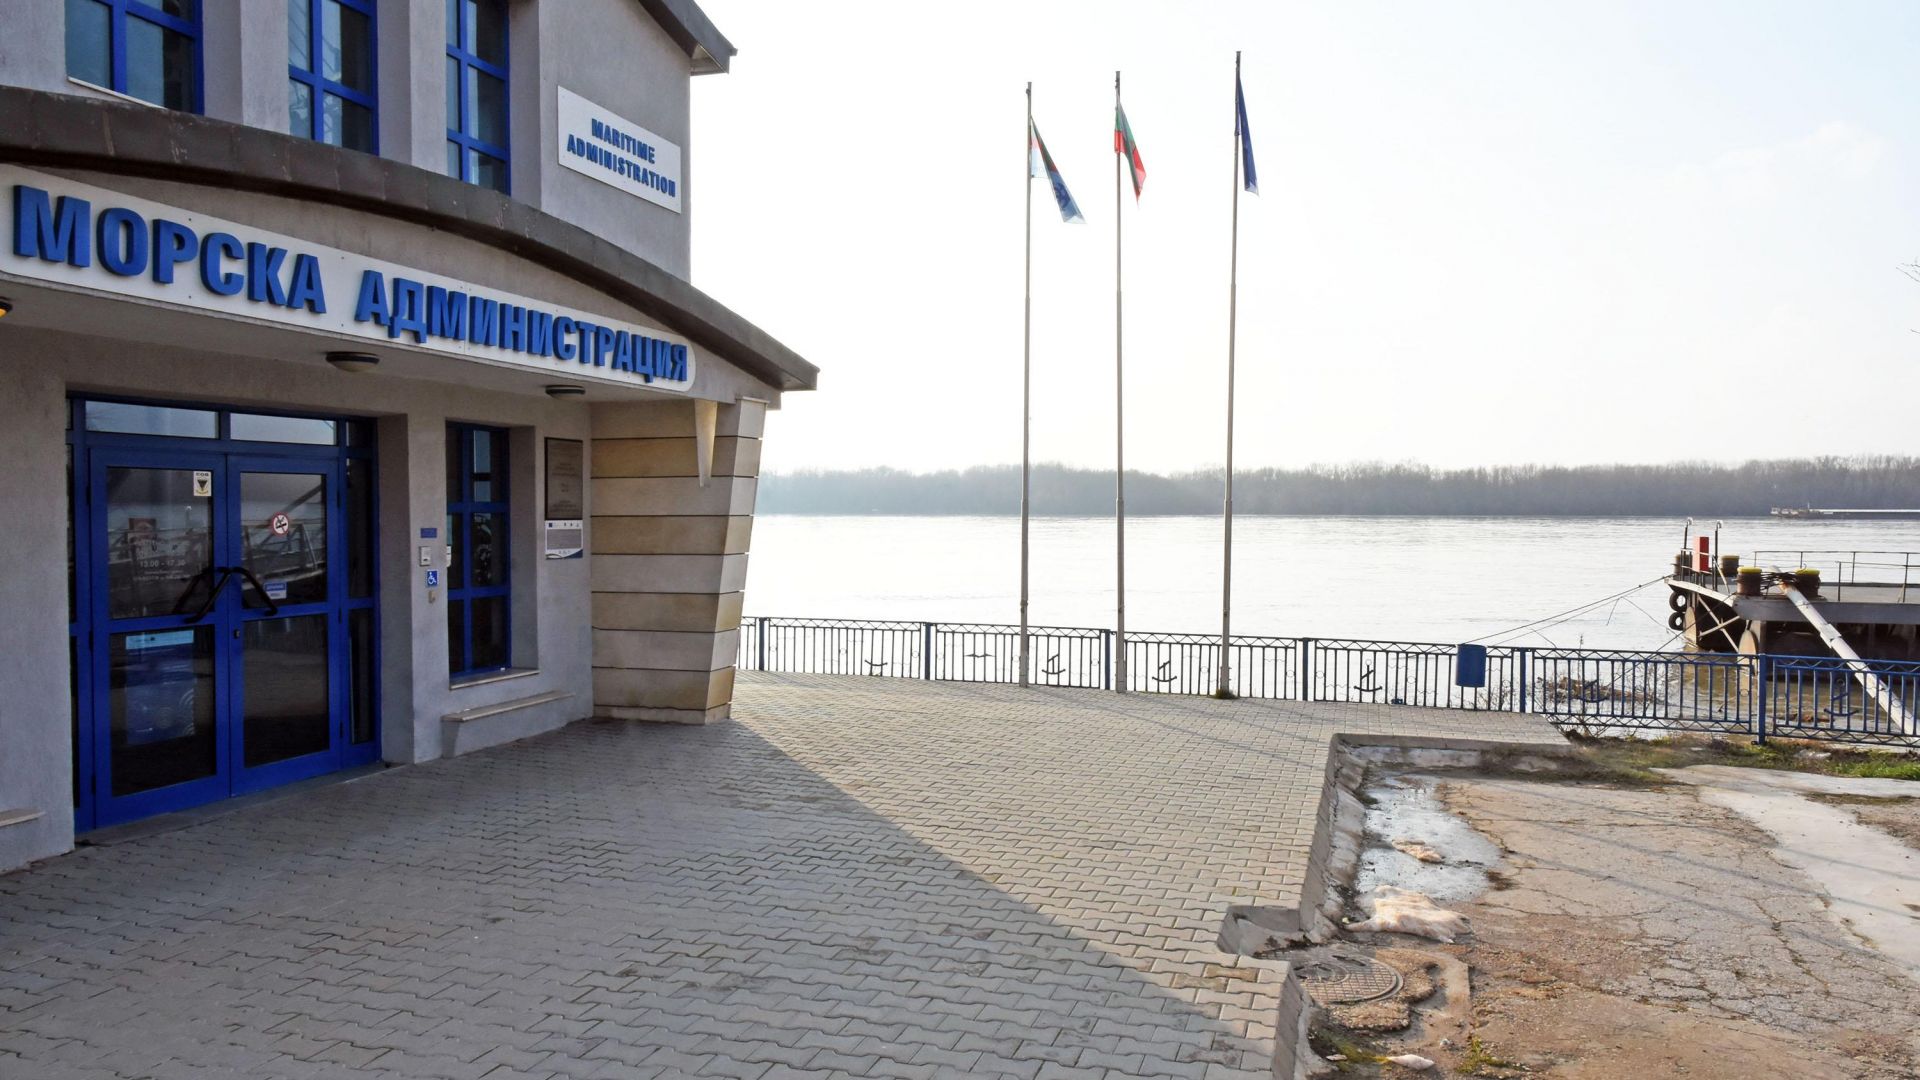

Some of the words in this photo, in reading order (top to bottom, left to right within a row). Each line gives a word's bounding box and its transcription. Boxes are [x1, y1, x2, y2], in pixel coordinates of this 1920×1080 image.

[567, 133, 676, 198] ADMINISTRATION
[591, 118, 655, 164] MARITIME
[13, 184, 327, 314] МОРСКА
[354, 269, 688, 383] АДМИНИСТРАЦИЯ
